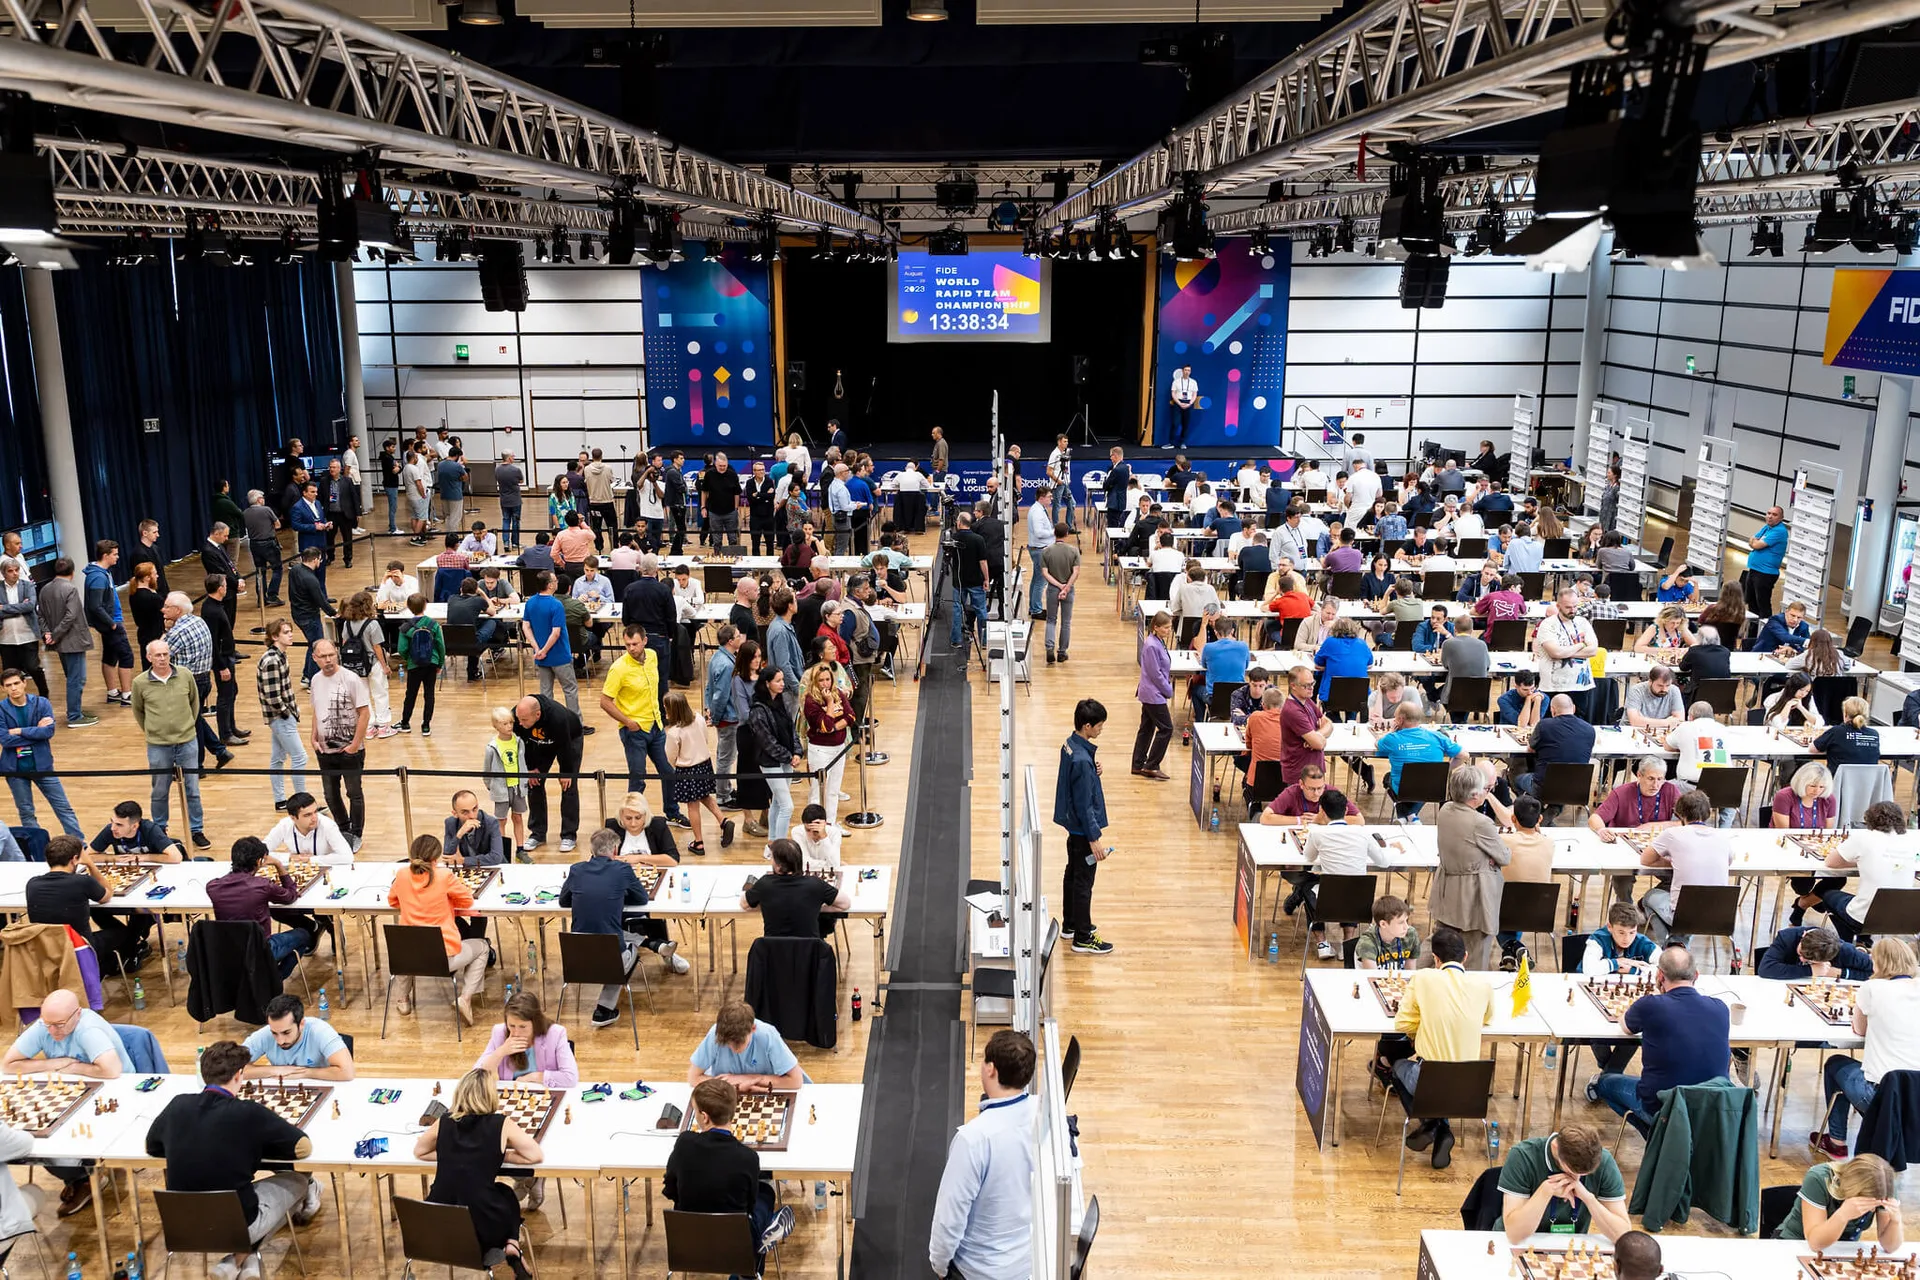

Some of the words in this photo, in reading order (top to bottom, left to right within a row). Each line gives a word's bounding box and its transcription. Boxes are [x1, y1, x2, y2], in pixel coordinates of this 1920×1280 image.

[935, 267, 958, 275] FIDE
[935, 278, 980, 286] WORLD
[904, 285, 925, 293] 2023
[935, 290, 973, 298] RAPID
[976, 290, 1011, 298] TEAM
[935, 301, 1031, 309] CHAMPIONSHIP
[929, 313, 1009, 330] 13:38:34
[1375, 407, 1382, 418] F
[963, 477, 977, 485] WR
